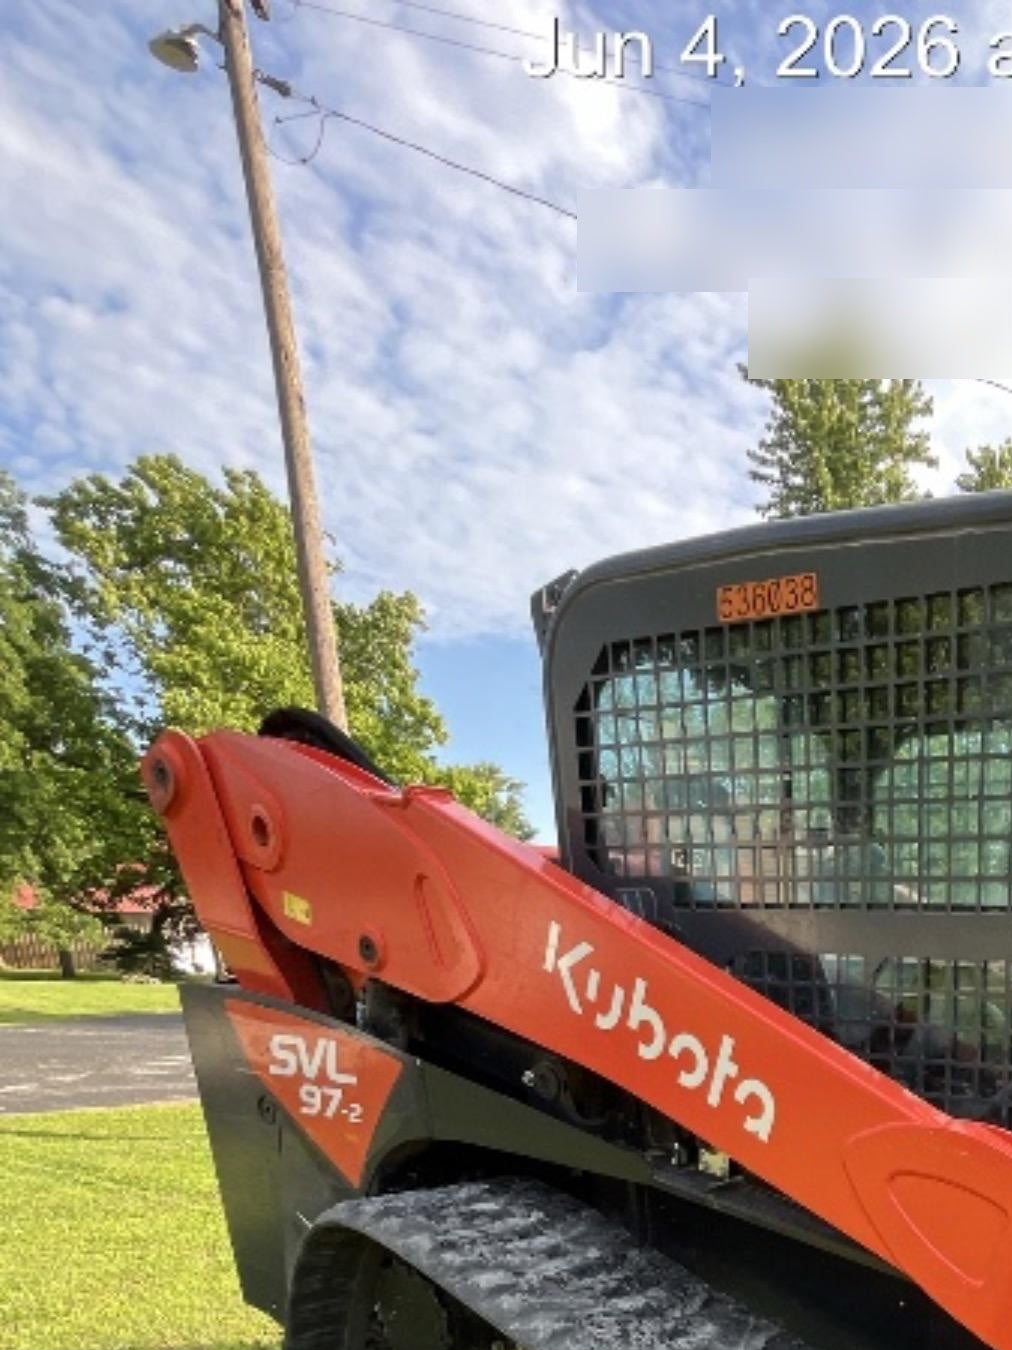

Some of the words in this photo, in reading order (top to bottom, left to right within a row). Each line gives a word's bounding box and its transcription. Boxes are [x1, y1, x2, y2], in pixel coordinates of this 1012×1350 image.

[720, 575, 816, 619] 536038
[543, 920, 775, 1143] Kubota
[269, 1034, 358, 1085] SVL
[299, 1083, 364, 1123] 97-2
